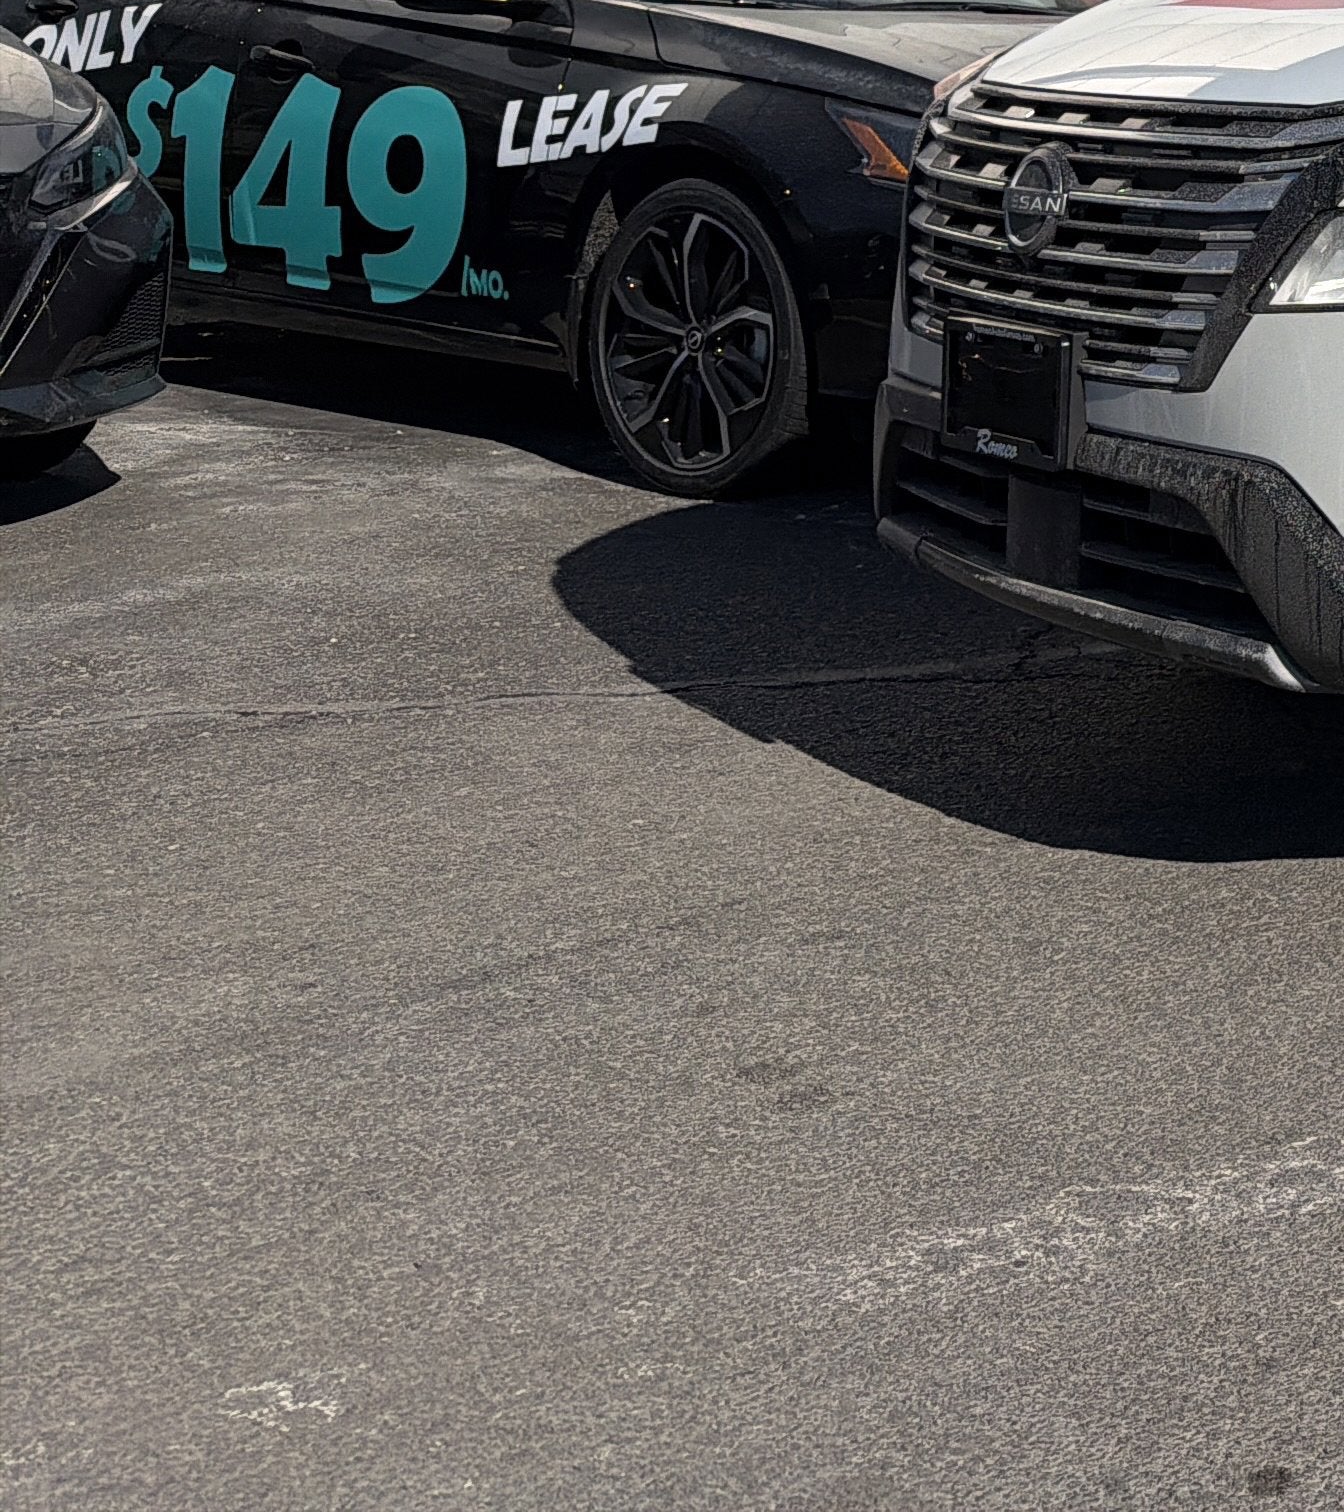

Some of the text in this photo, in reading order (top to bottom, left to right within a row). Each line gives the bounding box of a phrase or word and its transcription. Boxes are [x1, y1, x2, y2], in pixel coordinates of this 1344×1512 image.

[24, 2, 163, 74] ONLY
[496, 82, 688, 168] LEASE
[127, 66, 467, 305] $149
[976, 428, 1018, 460] Romeo
